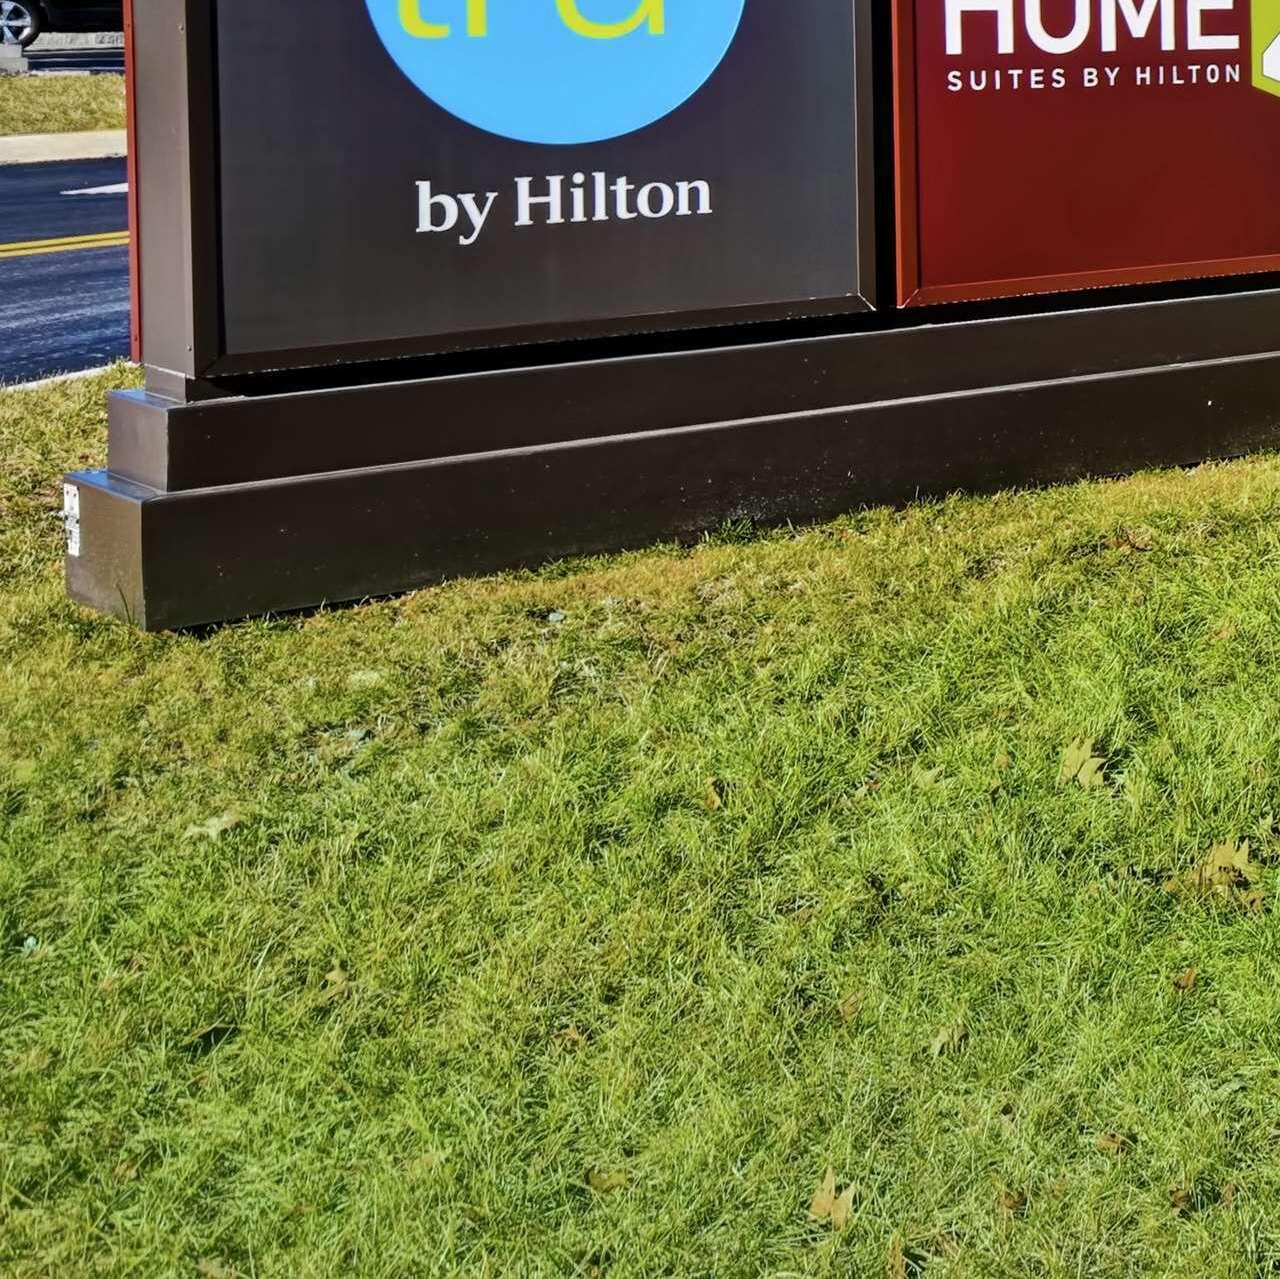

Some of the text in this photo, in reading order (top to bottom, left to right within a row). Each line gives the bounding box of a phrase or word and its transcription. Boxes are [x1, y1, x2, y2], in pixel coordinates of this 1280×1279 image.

[946, 63, 1241, 93] SUITES BY HILTON
[415, 171, 713, 246] by Hilton
